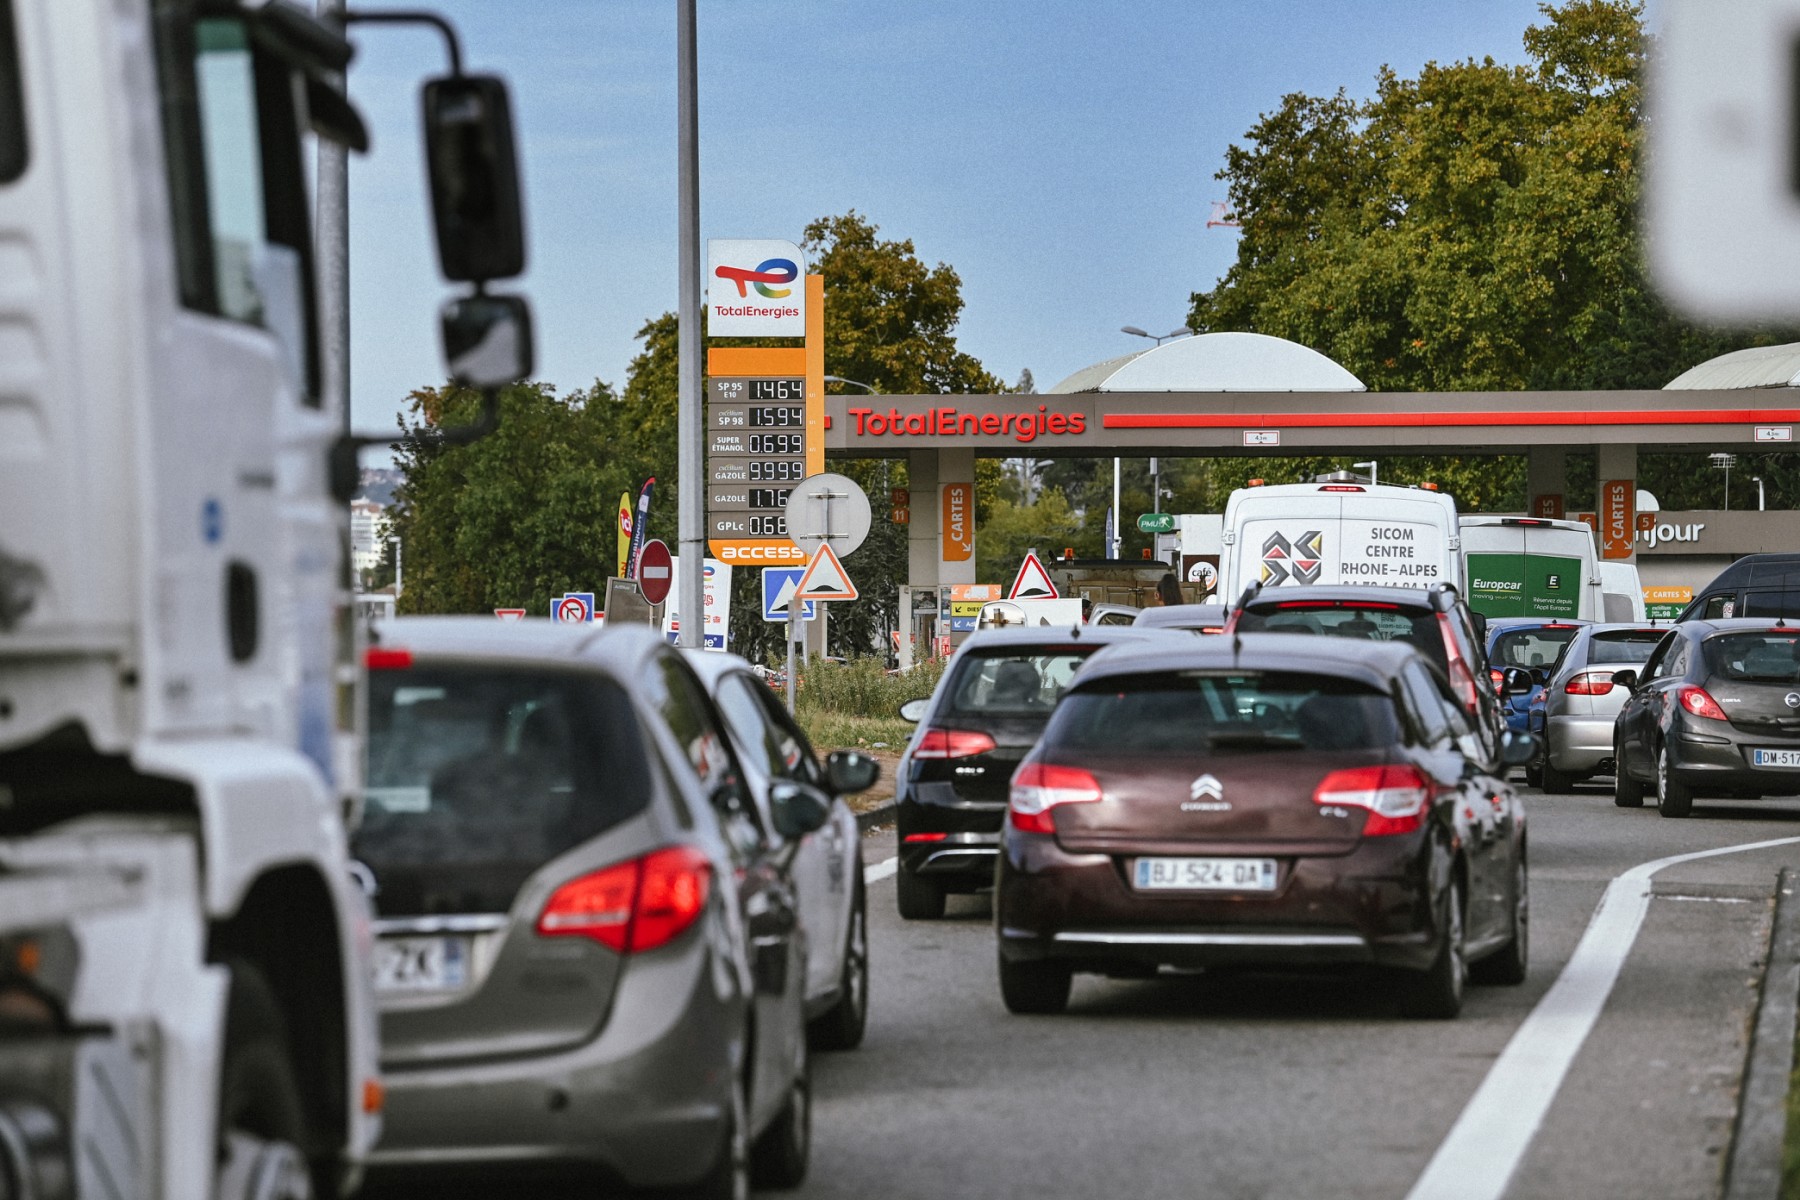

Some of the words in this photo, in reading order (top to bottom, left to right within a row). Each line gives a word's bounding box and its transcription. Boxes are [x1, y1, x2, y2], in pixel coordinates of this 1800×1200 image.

[715, 306, 799, 319] TotalEnergies
[718, 383, 730, 391] SP
[732, 383, 743, 391] 95
[757, 381, 802, 399] 1.464
[718, 417, 730, 425] SP
[732, 417, 744, 425] 98
[757, 408, 802, 426] 1.594
[849, 404, 1086, 442] TotalEnergies
[712, 444, 744, 452] ÉTHANOL
[749, 435, 802, 453] 0.699
[715, 472, 746, 480] GAZOLE
[750, 462, 803, 480] 9.999
[757, 489, 788, 508] 1.76
[894, 510, 905, 521] 11
[951, 488, 964, 542] CARTES
[1612, 485, 1624, 539] CARTES
[717, 522, 744, 531] GPLc
[749, 516, 788, 535] 0.6
[1141, 520, 1158, 528] PMU
[1642, 518, 1649, 528] 5
[1371, 528, 1414, 540] SICOM
[1366, 545, 1414, 558] CENTRE
[1192, 567, 1212, 577] café
[1472, 578, 1522, 592] Europcar
[1549, 575, 1558, 585] E
[1556, 597, 1572, 605] depuis
[1549, 604, 1572, 612] Europcar
